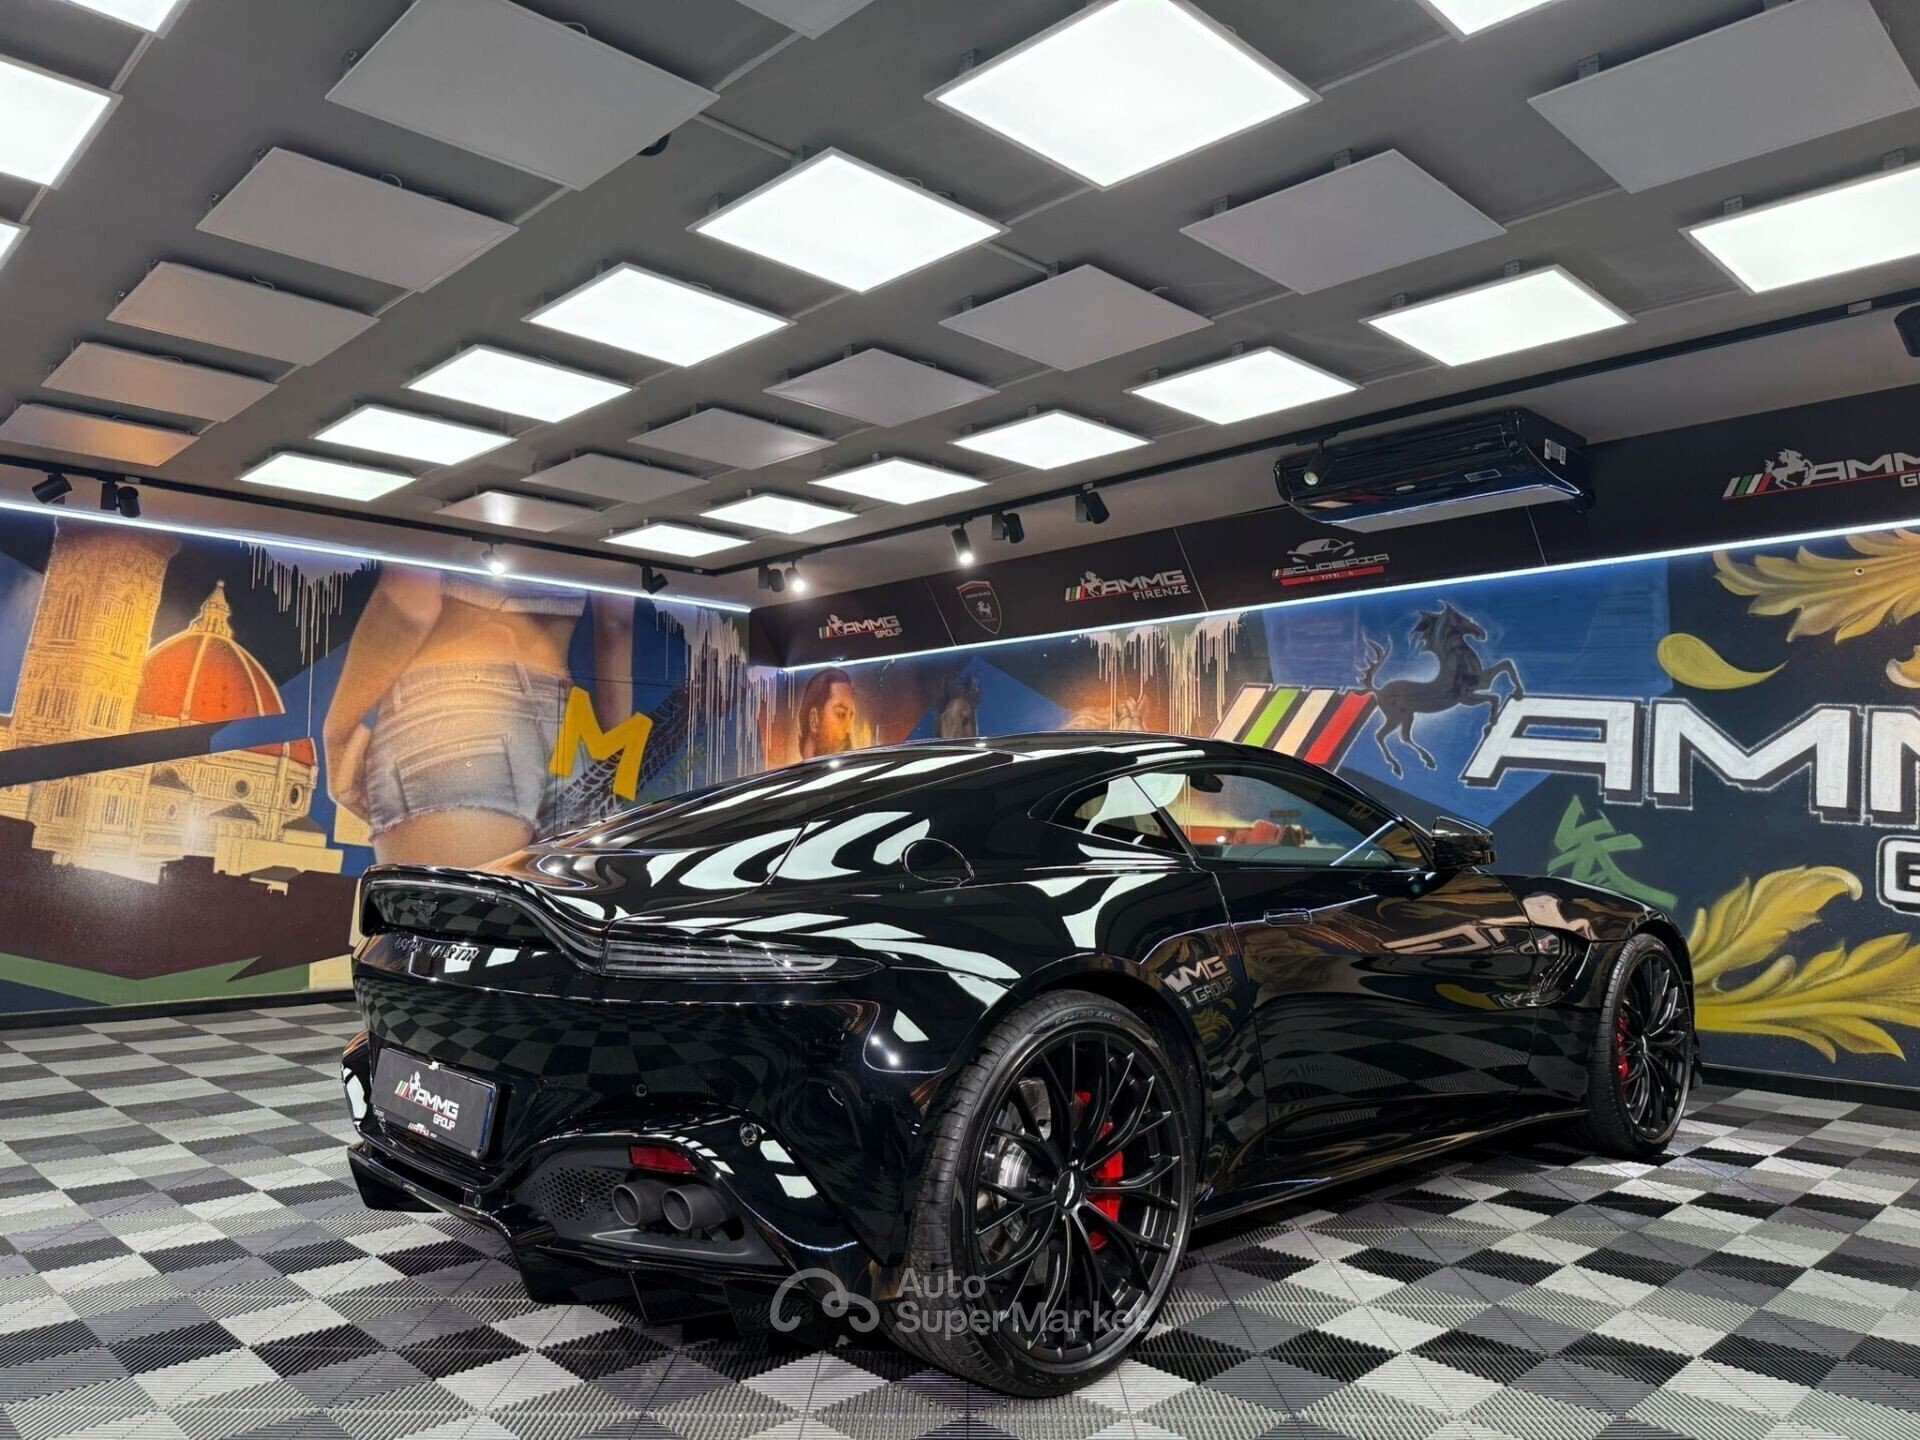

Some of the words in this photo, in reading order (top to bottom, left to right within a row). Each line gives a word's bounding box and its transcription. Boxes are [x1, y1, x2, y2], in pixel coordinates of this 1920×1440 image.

[1282, 553, 1390, 576] SCUDERIA
[1101, 569, 1186, 595] AMMG
[1132, 584, 1191, 601] FIRENZE
[843, 615, 900, 635] AMMG
[1463, 697, 1920, 818] AM
[414, 1088, 459, 1120] AMMG
[432, 1113, 456, 1131] GROUP
